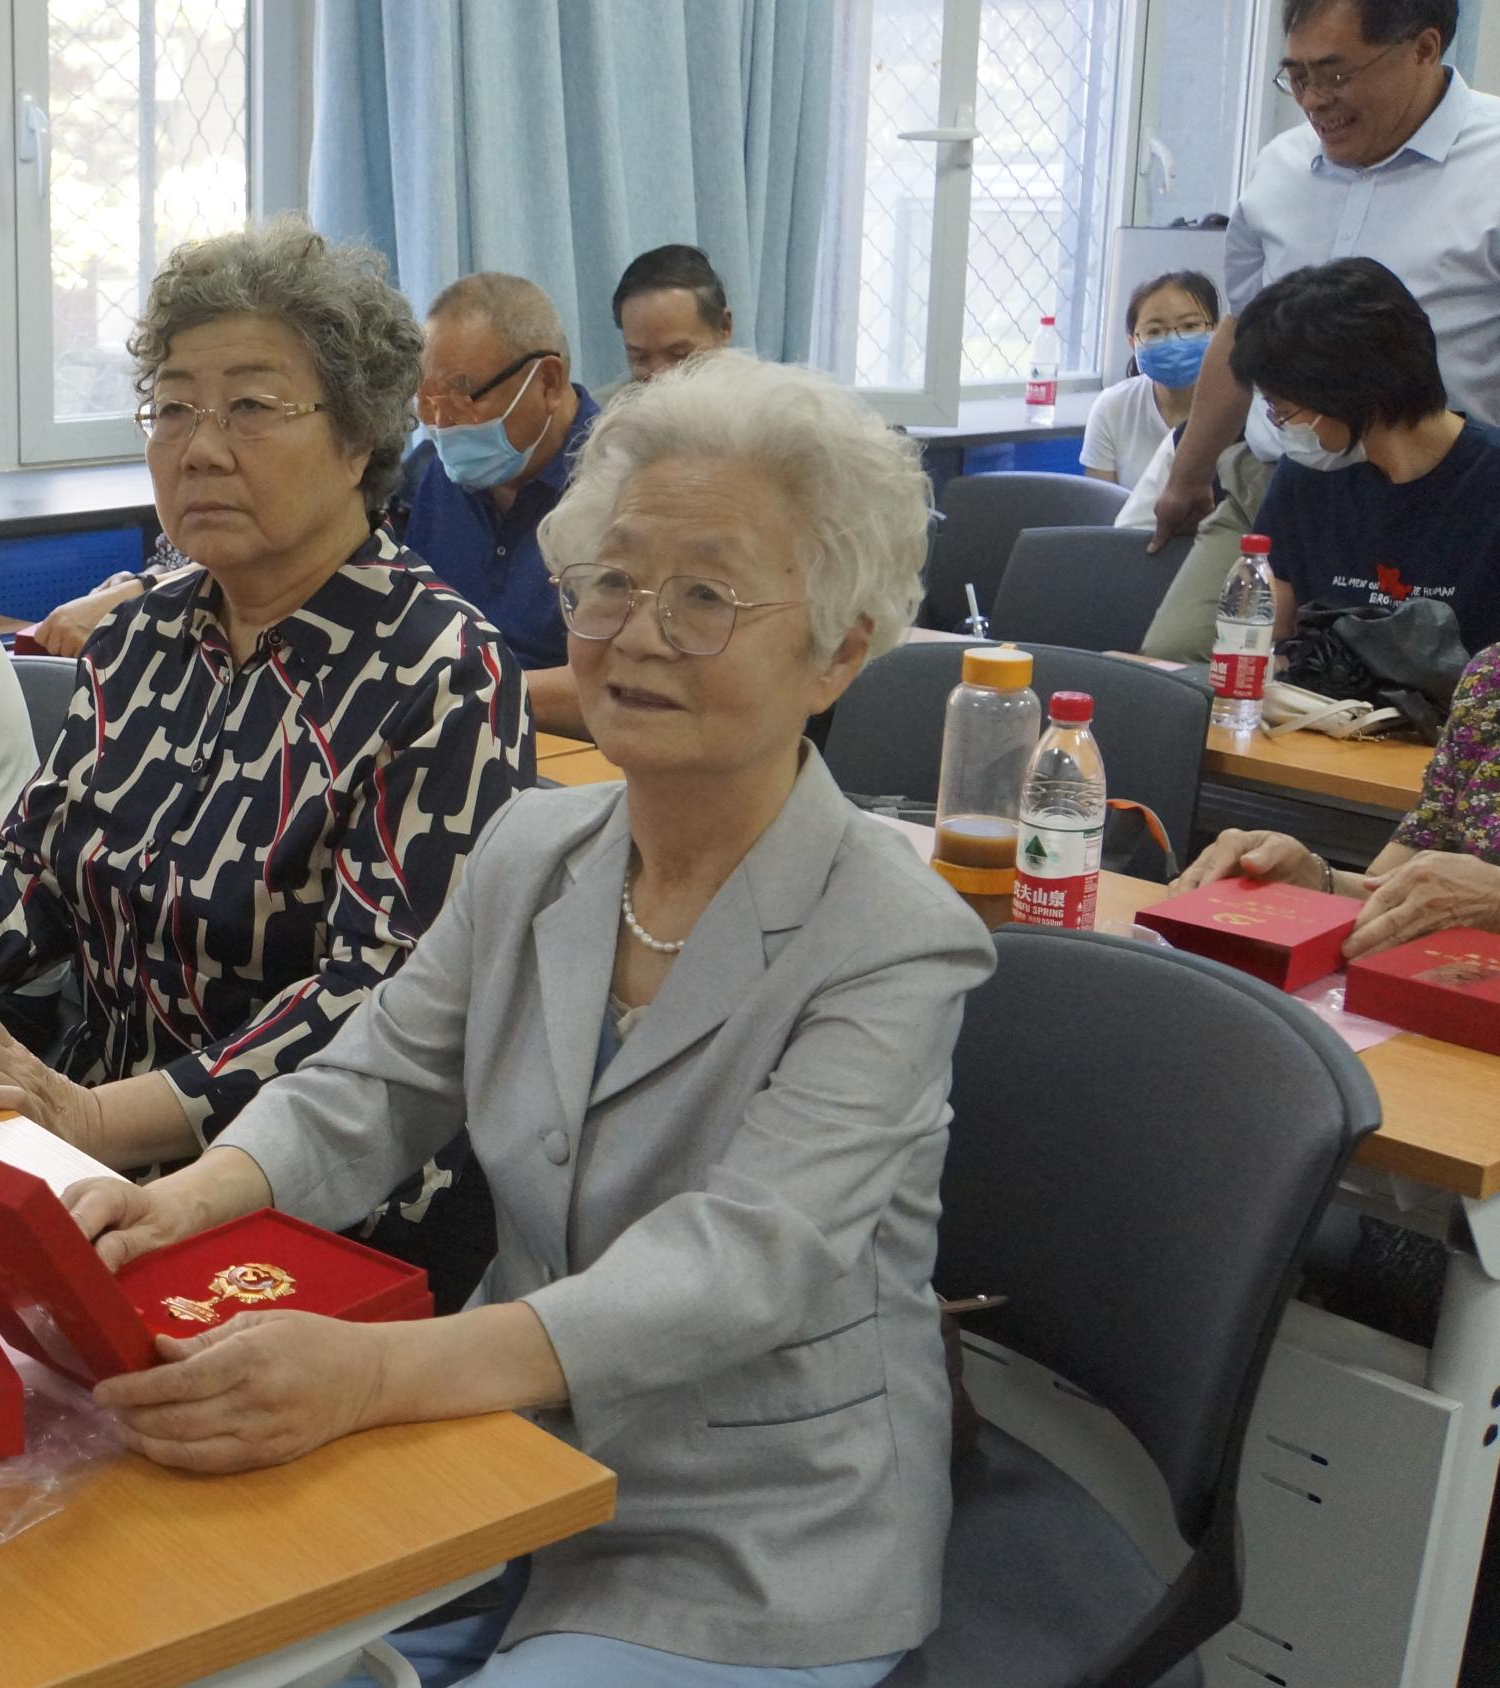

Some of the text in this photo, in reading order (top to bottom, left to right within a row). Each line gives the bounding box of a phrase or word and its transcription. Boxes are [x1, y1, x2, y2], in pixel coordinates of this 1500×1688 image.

[1332, 576, 1347, 586] ALL
[1423, 586, 1456, 597] HUMAN
[1033, 905, 1064, 918] SPRING
